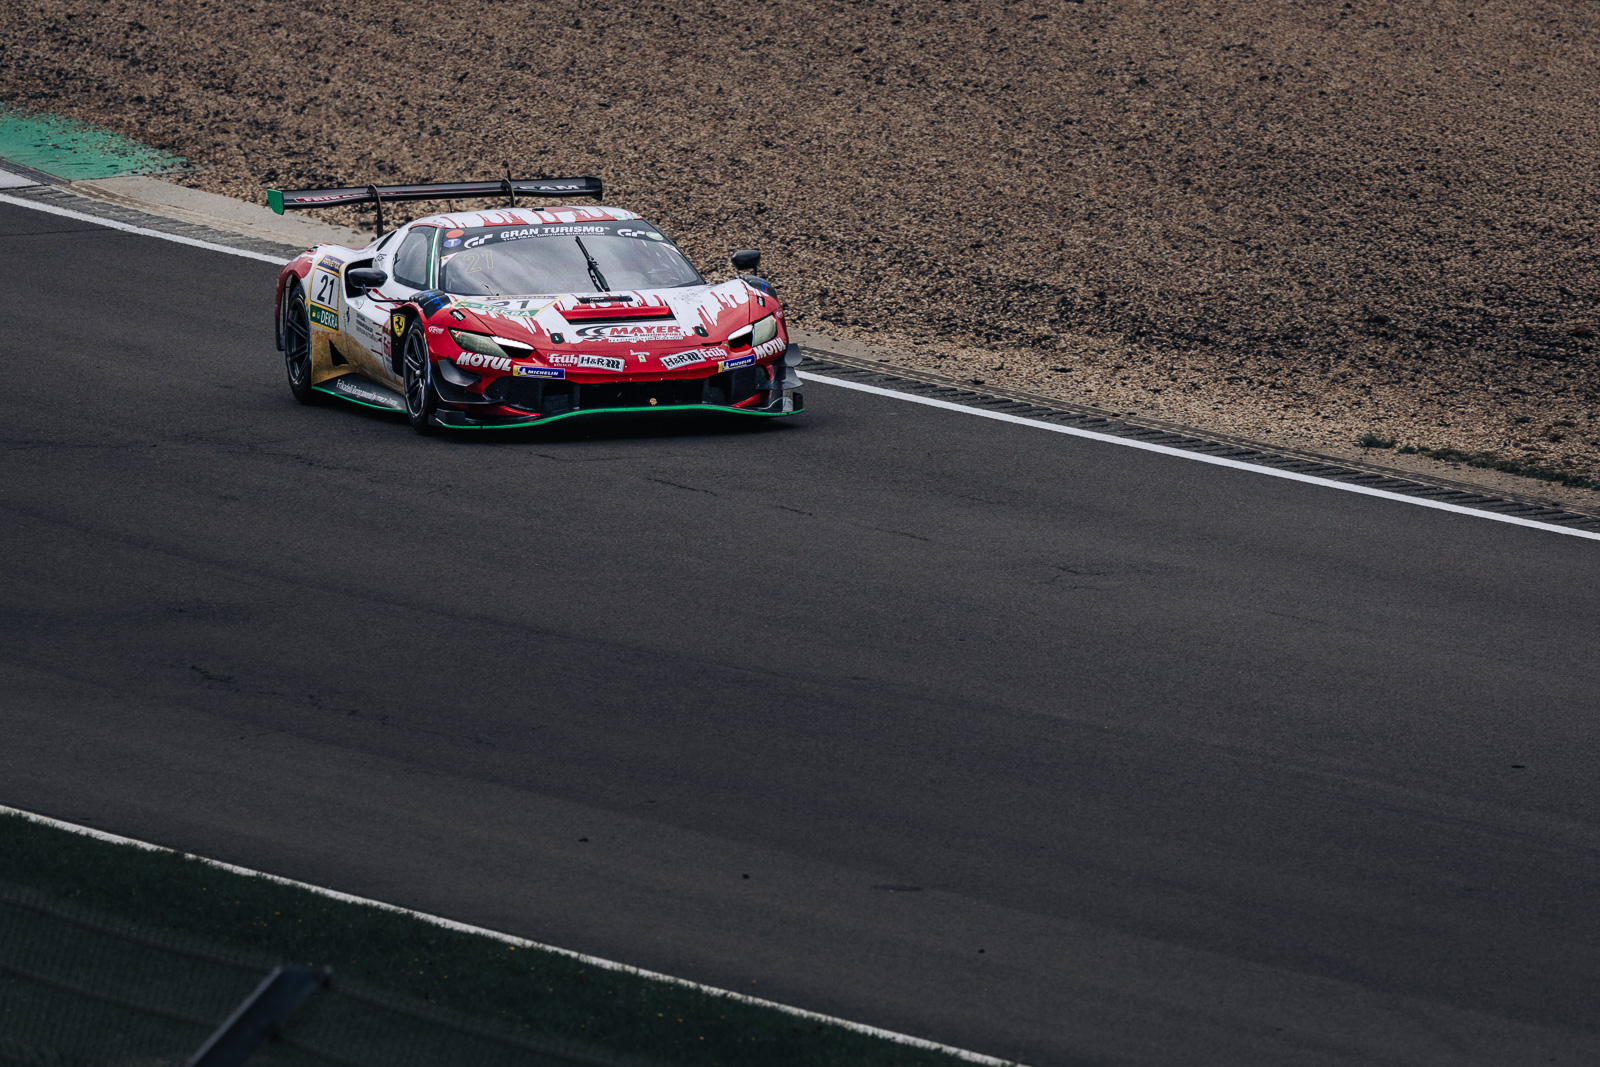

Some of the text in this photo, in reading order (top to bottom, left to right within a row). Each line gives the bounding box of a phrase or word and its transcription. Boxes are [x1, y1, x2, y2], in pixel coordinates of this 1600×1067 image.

[500, 226, 604, 239] GRAN TURISMO
[462, 250, 495, 274] 21
[316, 274, 335, 306] 21
[320, 310, 339, 329] DEKRA
[481, 306, 531, 317] DEKRA
[609, 326, 680, 336] MAYER
[456, 351, 512, 372] MOTUL
[730, 359, 752, 367] MICHELIN
